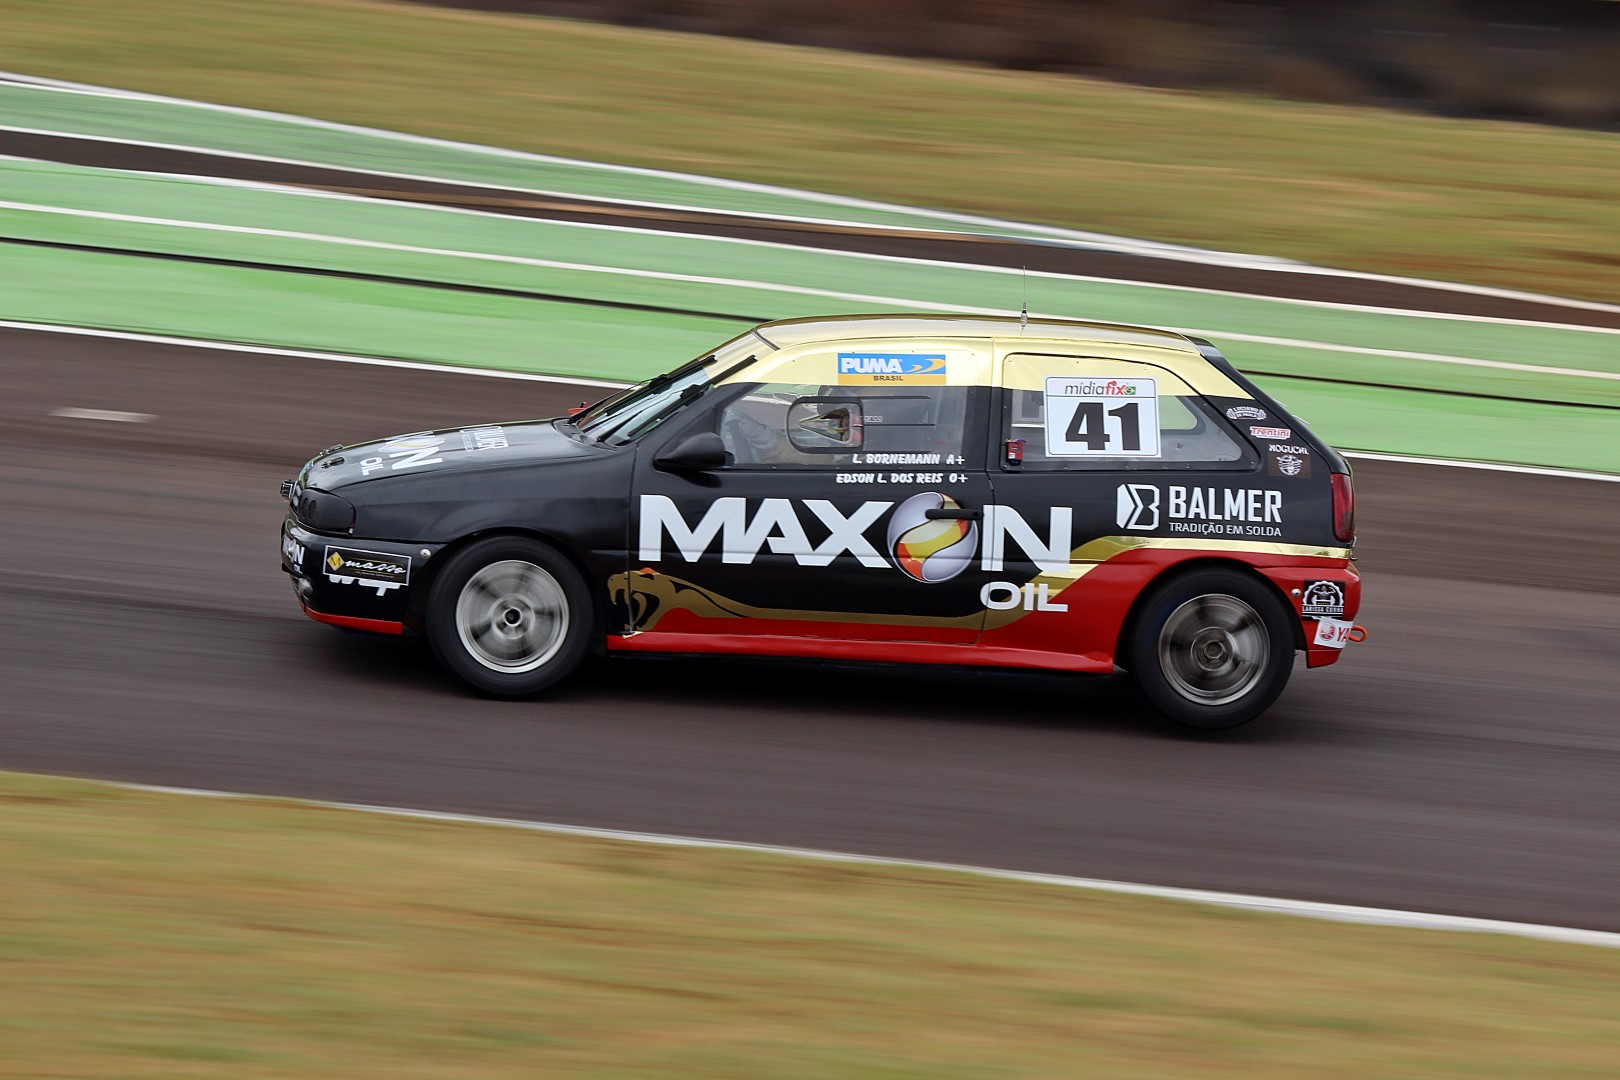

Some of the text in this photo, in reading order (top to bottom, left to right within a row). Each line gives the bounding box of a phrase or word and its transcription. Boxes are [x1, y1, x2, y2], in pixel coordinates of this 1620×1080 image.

[841, 358, 904, 373] PUMA
[1065, 402, 1141, 451] 41
[1251, 427, 1289, 436] Trentini
[360, 457, 384, 476] OIL
[866, 453, 941, 464] BORNEMANN
[946, 454, 966, 465] A+
[836, 473, 875, 484] EDSON
[890, 473, 914, 484] DOS
[916, 473, 944, 484] REIS
[1168, 485, 1282, 523] BALMER
[638, 491, 1073, 584] MAXON
[1169, 522, 1282, 537] TRADIÇÃO EM SOLDA
[980, 581, 1069, 612] OIL
